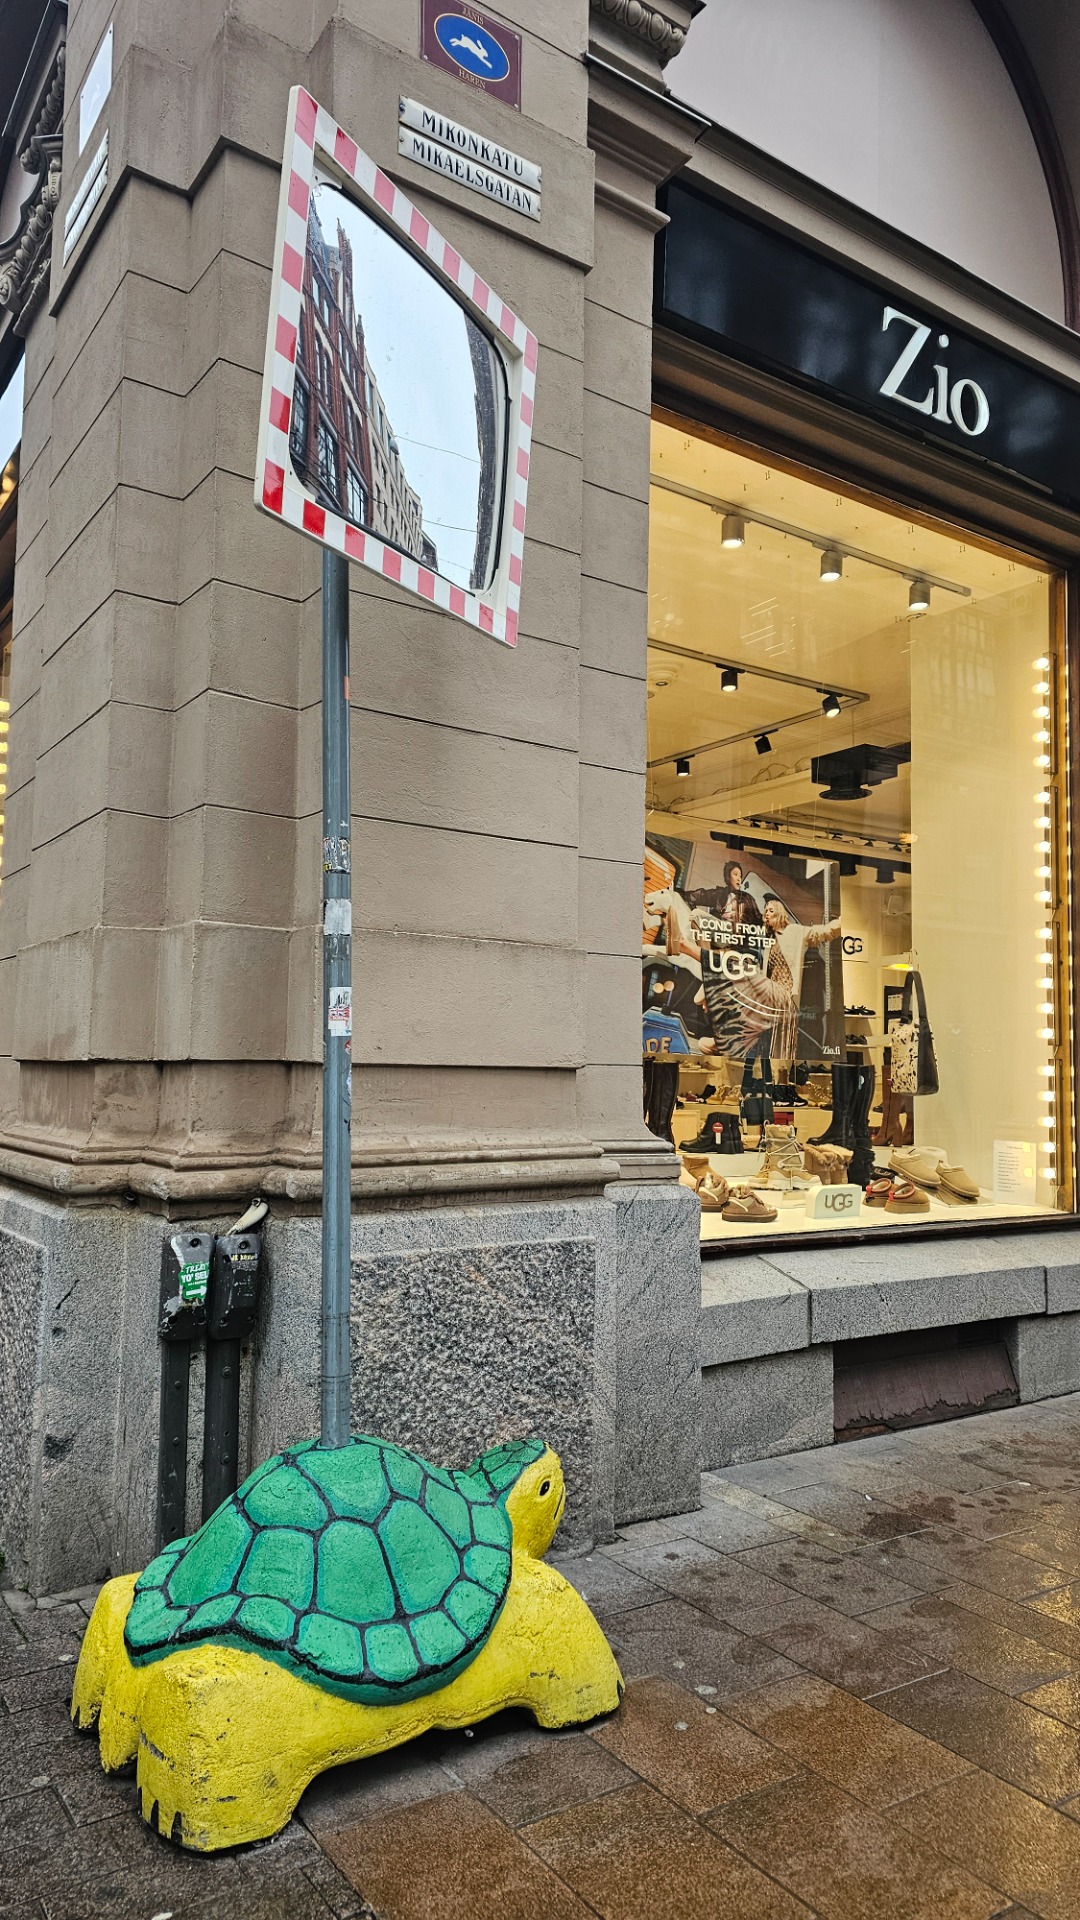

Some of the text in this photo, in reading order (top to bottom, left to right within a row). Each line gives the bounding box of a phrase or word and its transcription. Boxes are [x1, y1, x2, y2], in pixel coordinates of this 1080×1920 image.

[459, 69, 486, 89] HAREN
[421, 110, 523, 176] MIKONKATU
[412, 137, 532, 212] MIKAELSGATAN
[880, 306, 990, 436] Zio
[699, 918, 767, 936] ICONIC FROM
[690, 929, 776, 948] THE FIRST STEP
[841, 936, 863, 955] GG
[709, 950, 757, 980] UGG
[822, 1045, 841, 1055] Zio.fi
[825, 1193, 853, 1212] UGG
